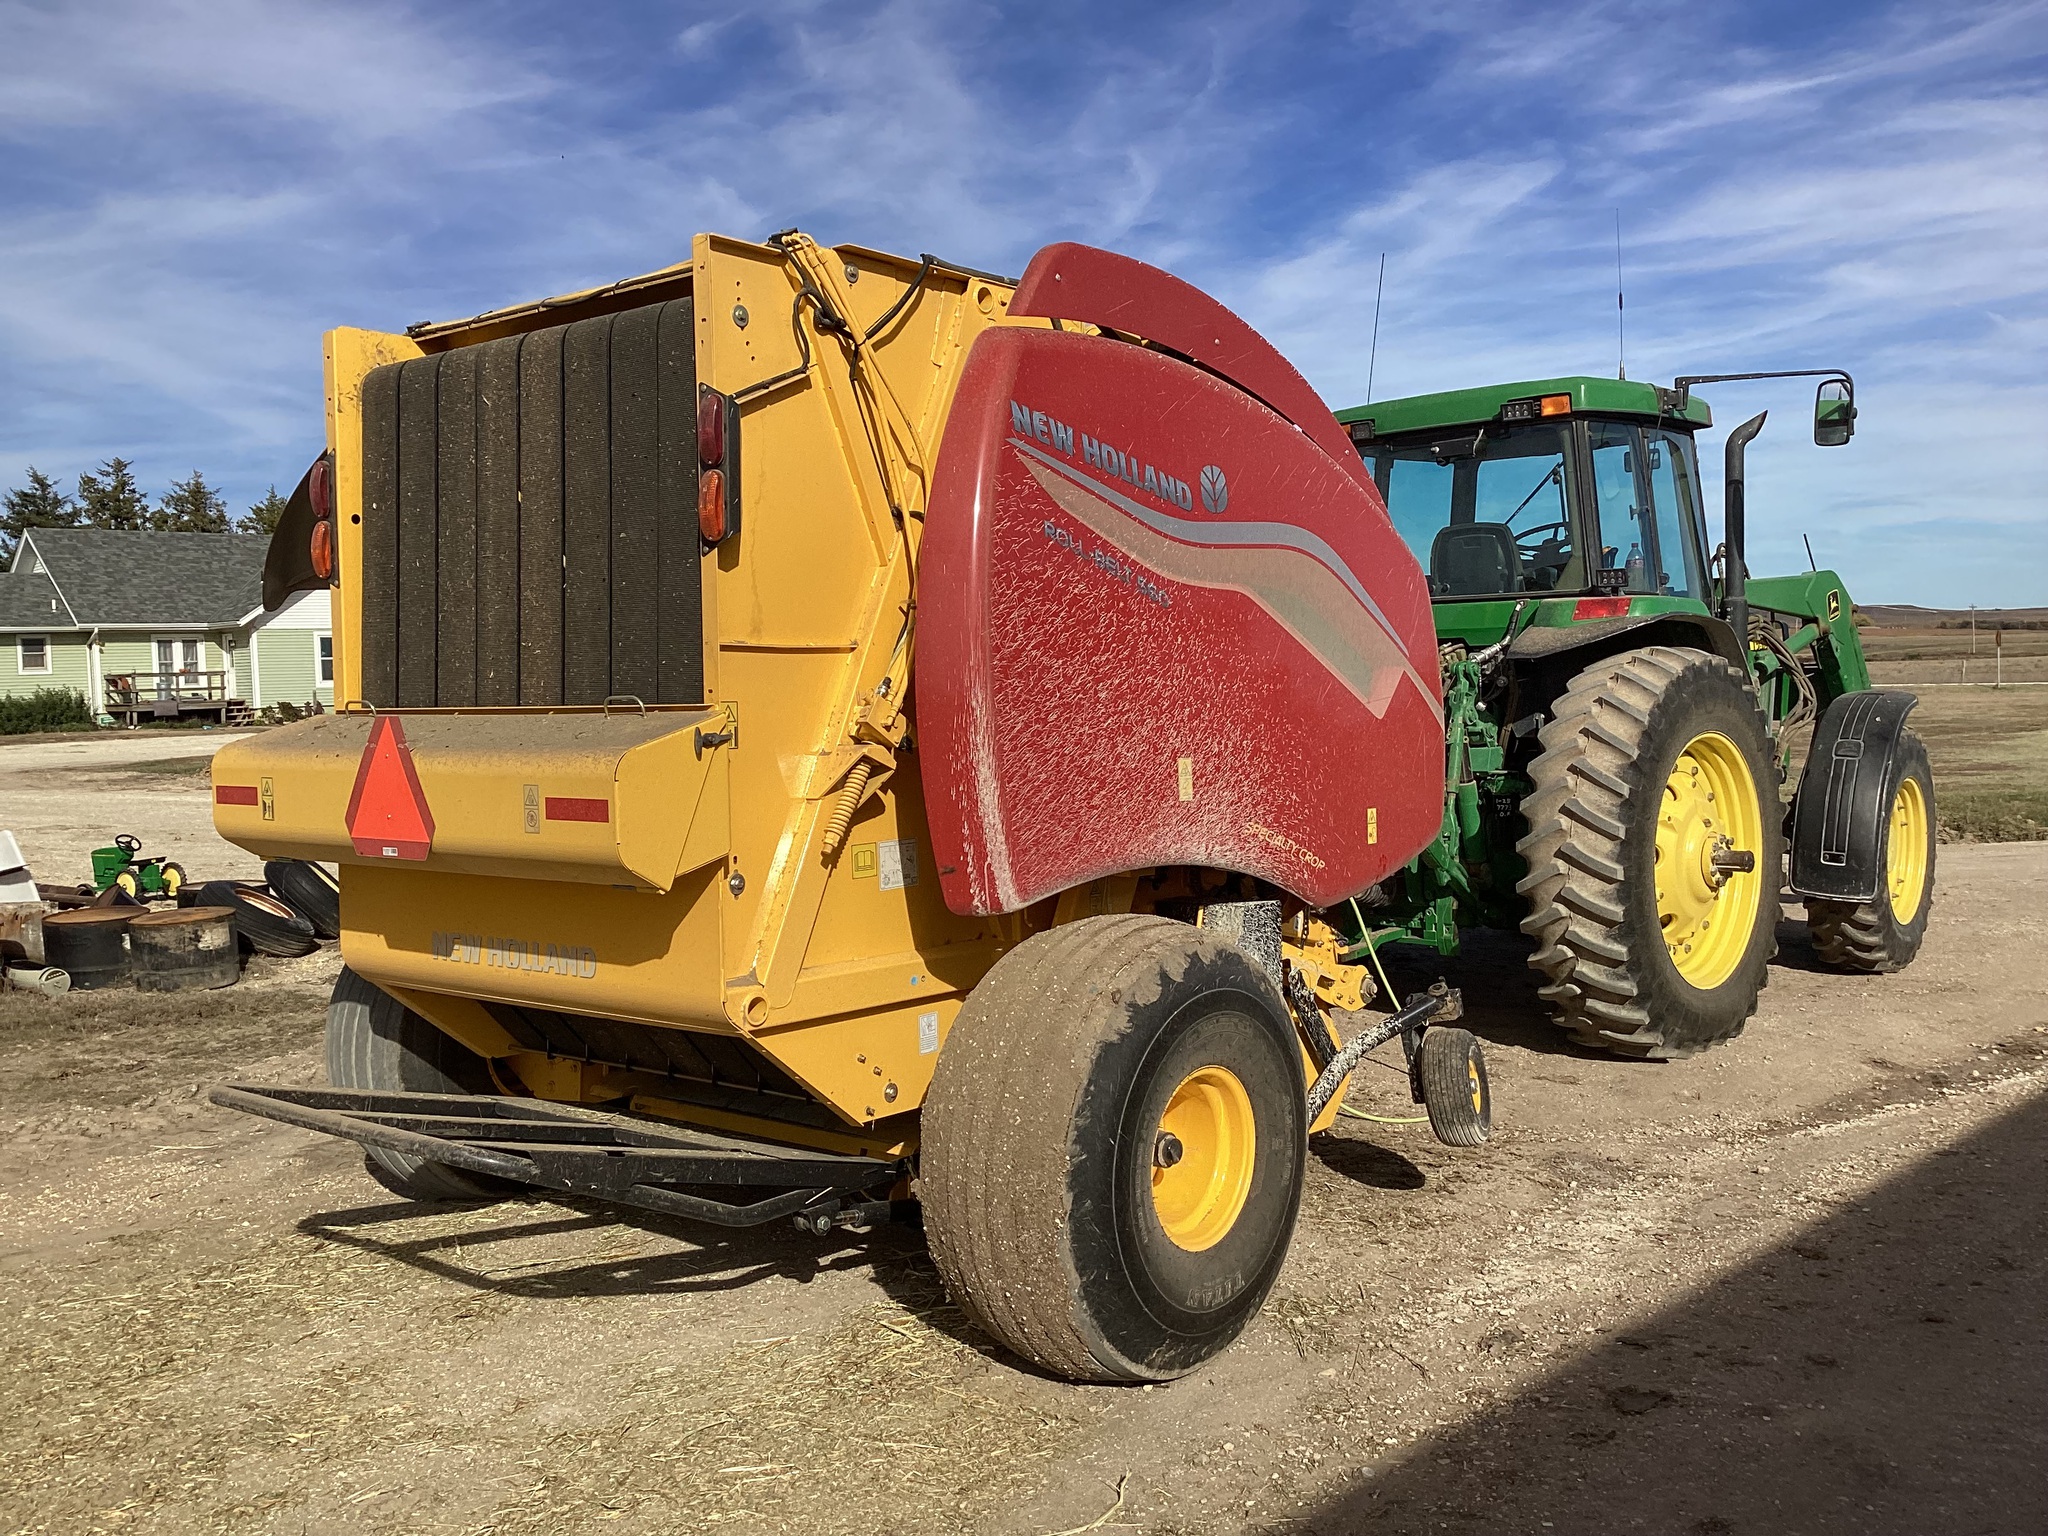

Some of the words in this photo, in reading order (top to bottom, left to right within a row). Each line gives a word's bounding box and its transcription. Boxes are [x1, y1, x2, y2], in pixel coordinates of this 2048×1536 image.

[1009, 400, 1074, 457] NEW
[1081, 432, 1193, 512] HOLLAND
[1244, 821, 1300, 860] SPECIALTY
[1299, 848, 1326, 870] CROP
[432, 931, 481, 965] NEW
[487, 936, 597, 979] HOLLAND
